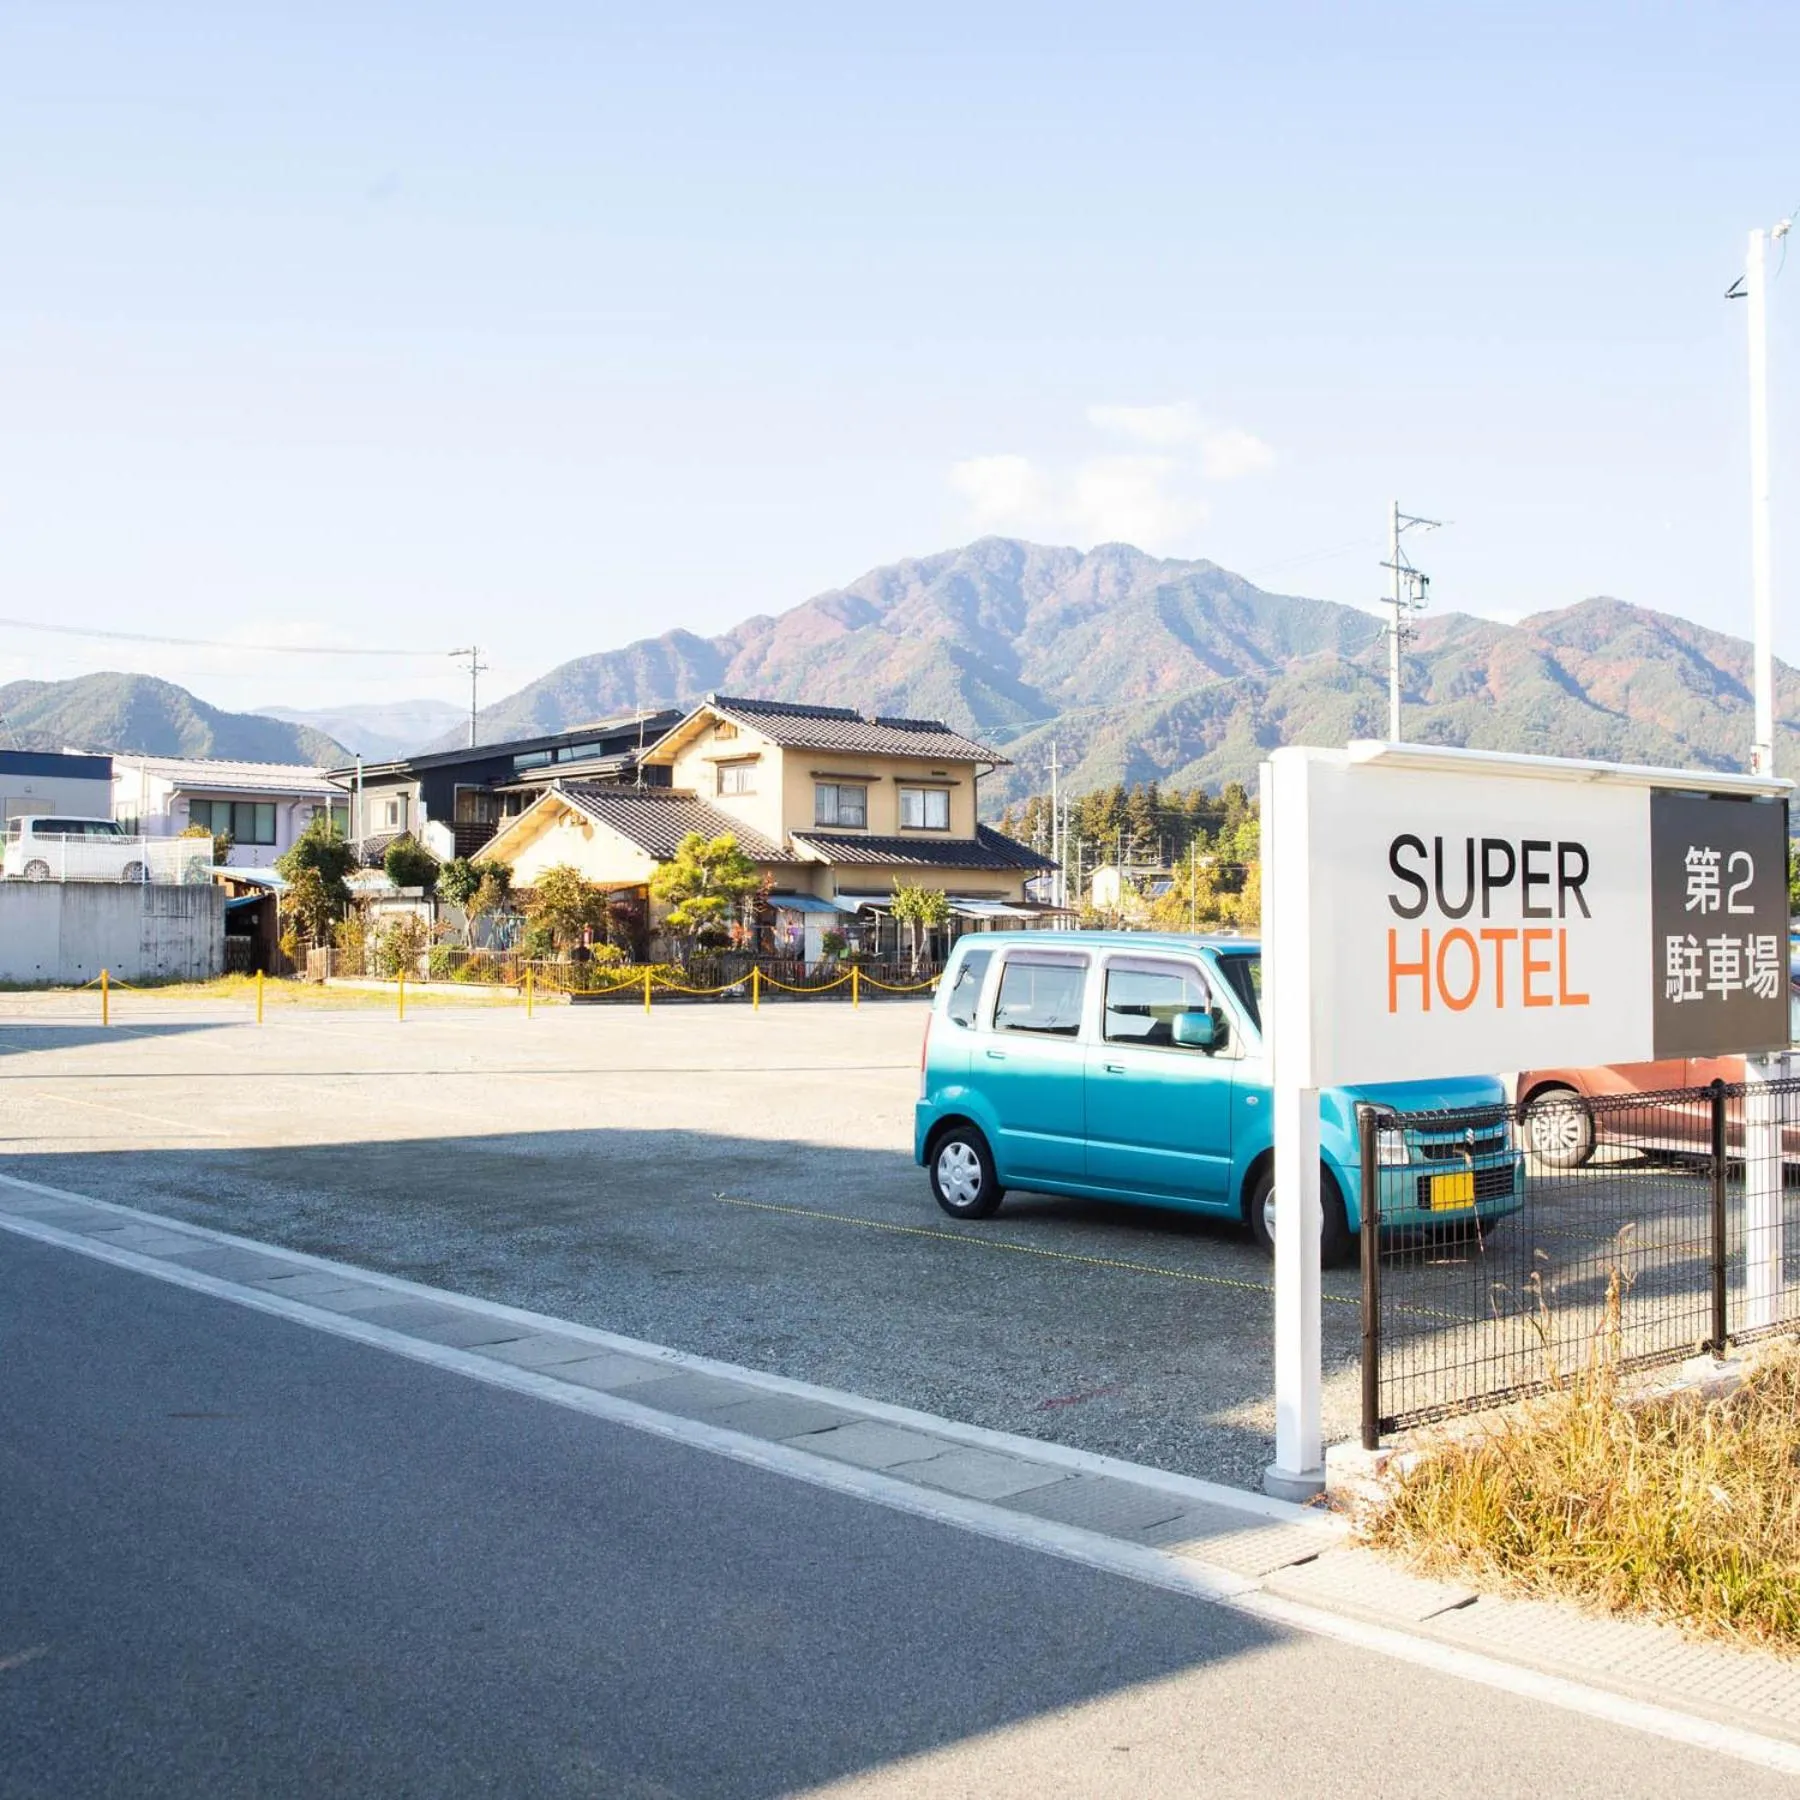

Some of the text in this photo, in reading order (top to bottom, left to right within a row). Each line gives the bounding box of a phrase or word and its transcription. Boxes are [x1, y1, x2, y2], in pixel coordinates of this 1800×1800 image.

[1388, 833, 1592, 920] SUPER
[1684, 845, 1755, 915] 第2
[1387, 927, 1591, 1014] HOTEL
[1665, 933, 1780, 1003] 駐車場
